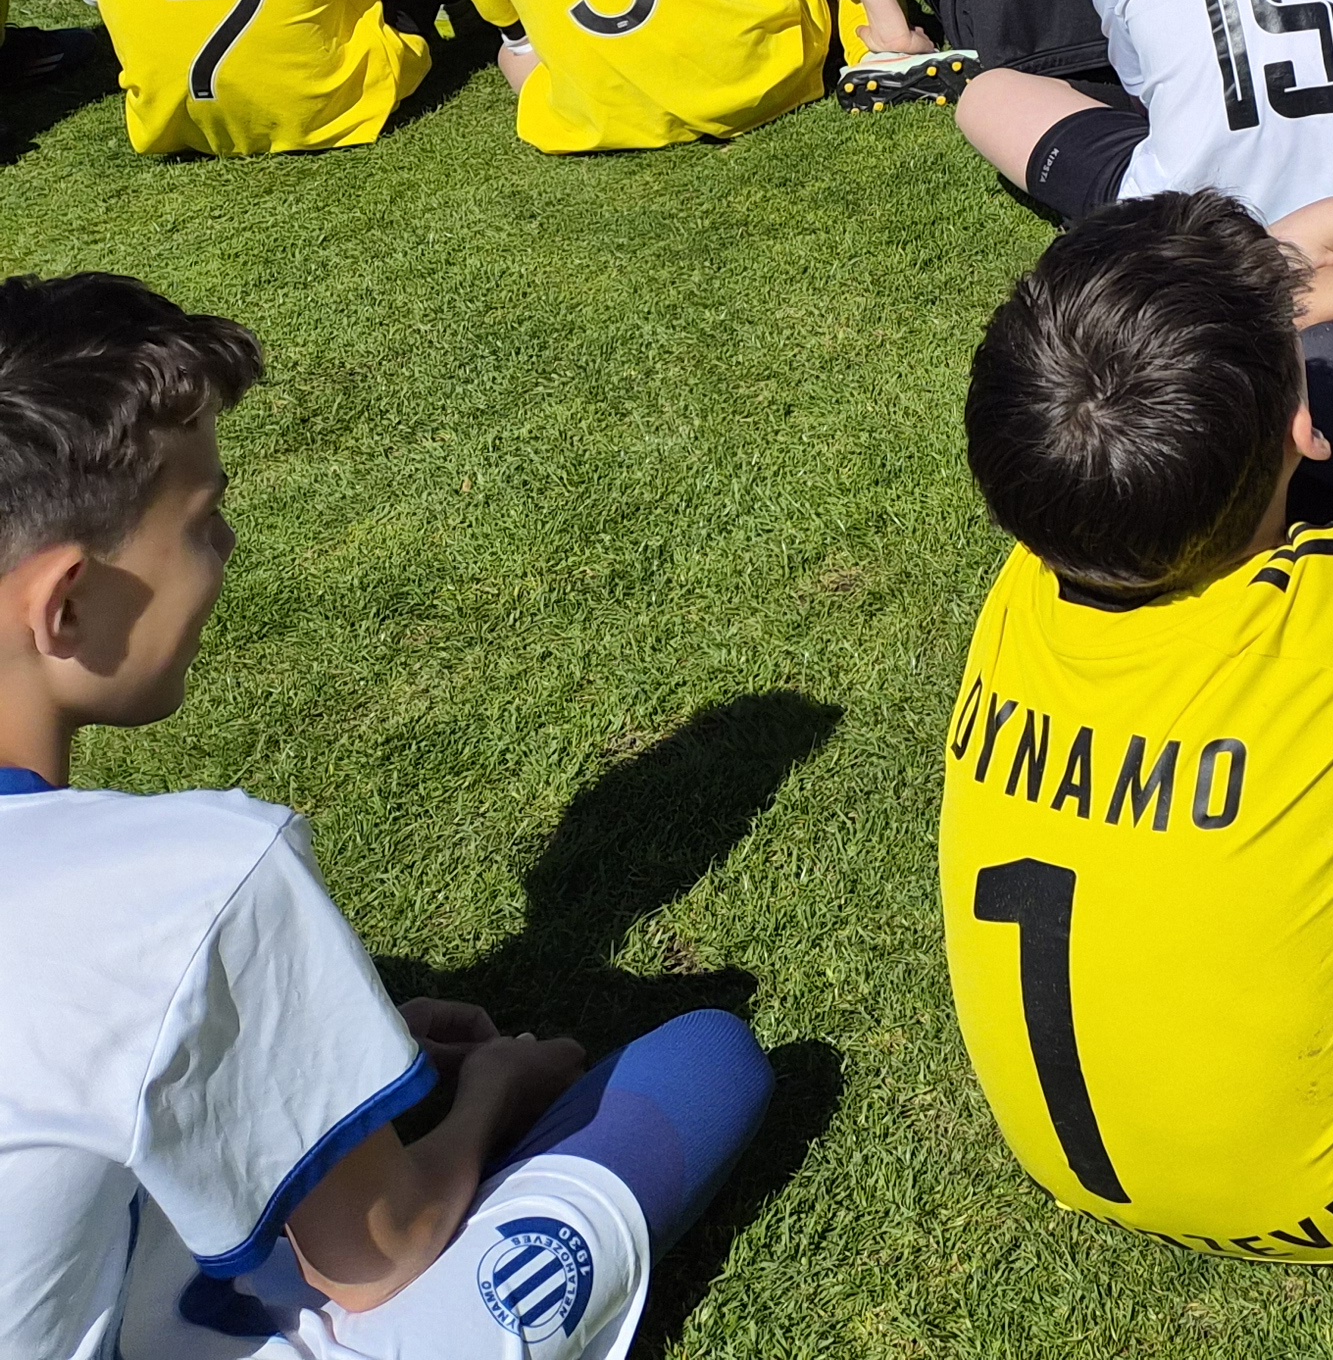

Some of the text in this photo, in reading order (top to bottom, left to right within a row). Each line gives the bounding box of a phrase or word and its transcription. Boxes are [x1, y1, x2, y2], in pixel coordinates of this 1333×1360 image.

[1040, 148, 1059, 182] KIPSTA
[950, 674, 1247, 833] DYNAMO
[973, 857, 1131, 1204] 1
[558, 1227, 591, 1276] 1930
[481, 1280, 518, 1330] YNAMO
